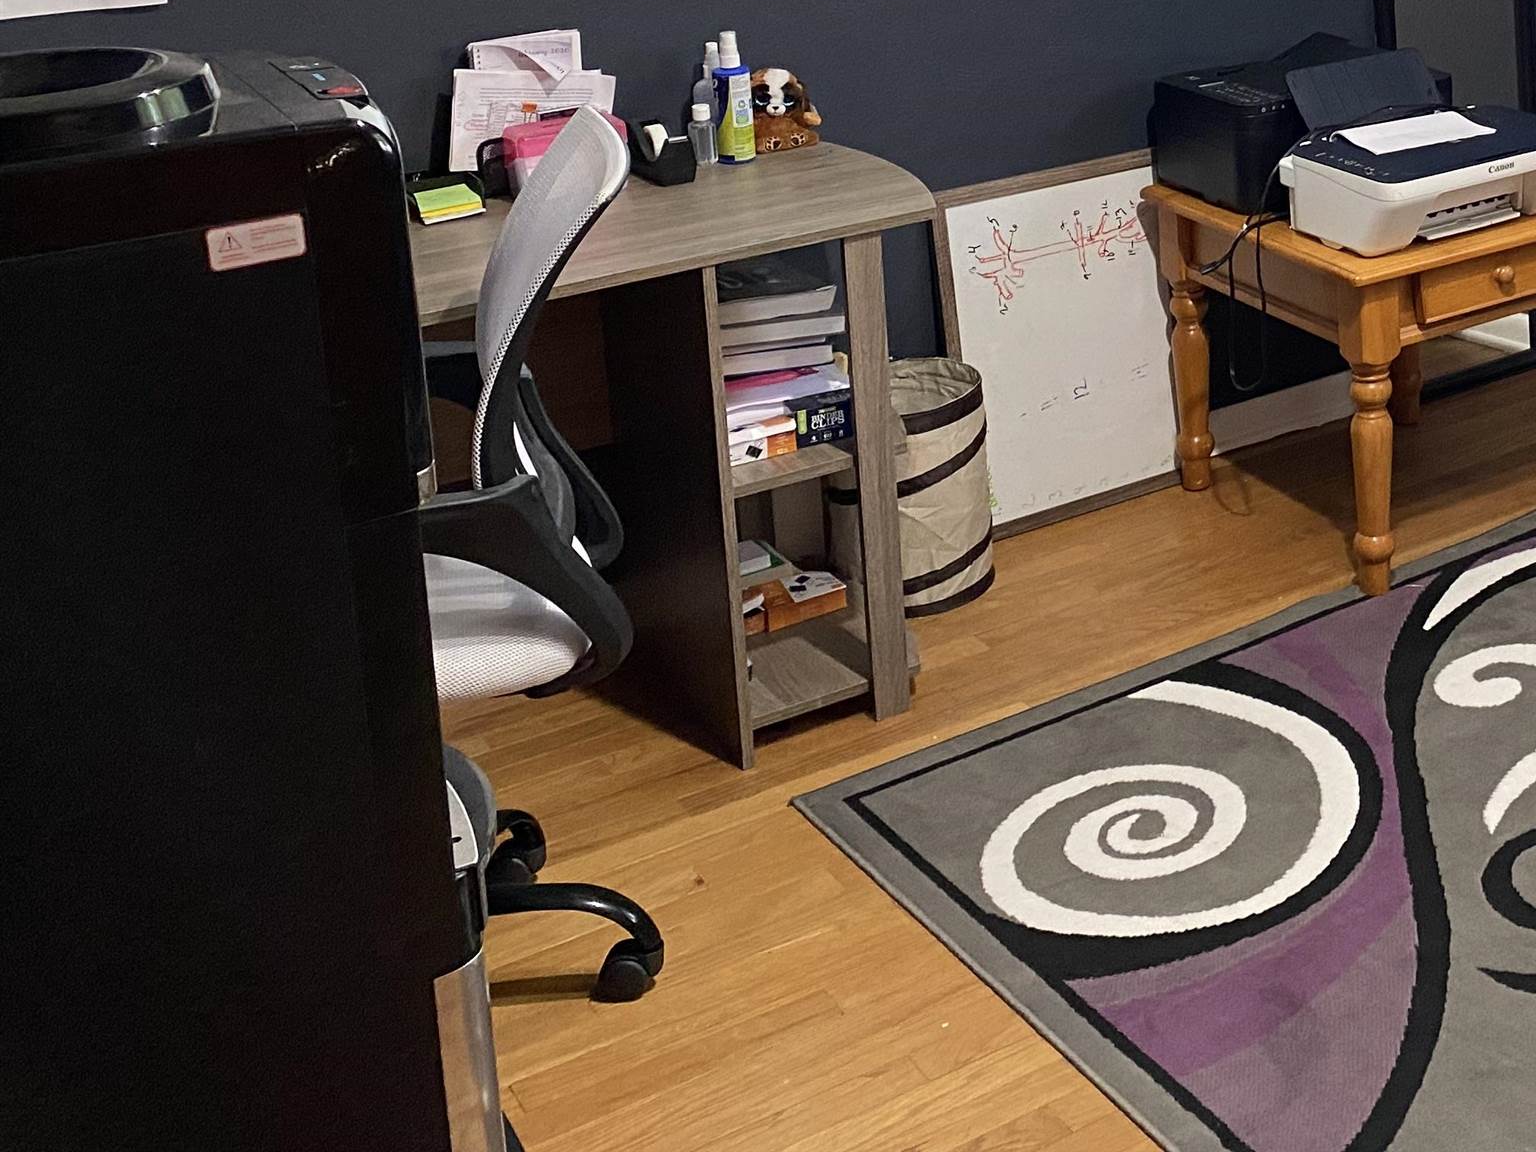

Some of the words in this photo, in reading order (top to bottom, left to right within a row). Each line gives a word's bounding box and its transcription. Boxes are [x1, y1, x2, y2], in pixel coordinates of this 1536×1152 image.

[1488, 161, 1515, 174] Canon
[967, 243, 982, 255] 4
[1073, 376, 1091, 401] 12
[811, 409, 845, 422] BINDER
[811, 415, 845, 430] CLIPS
